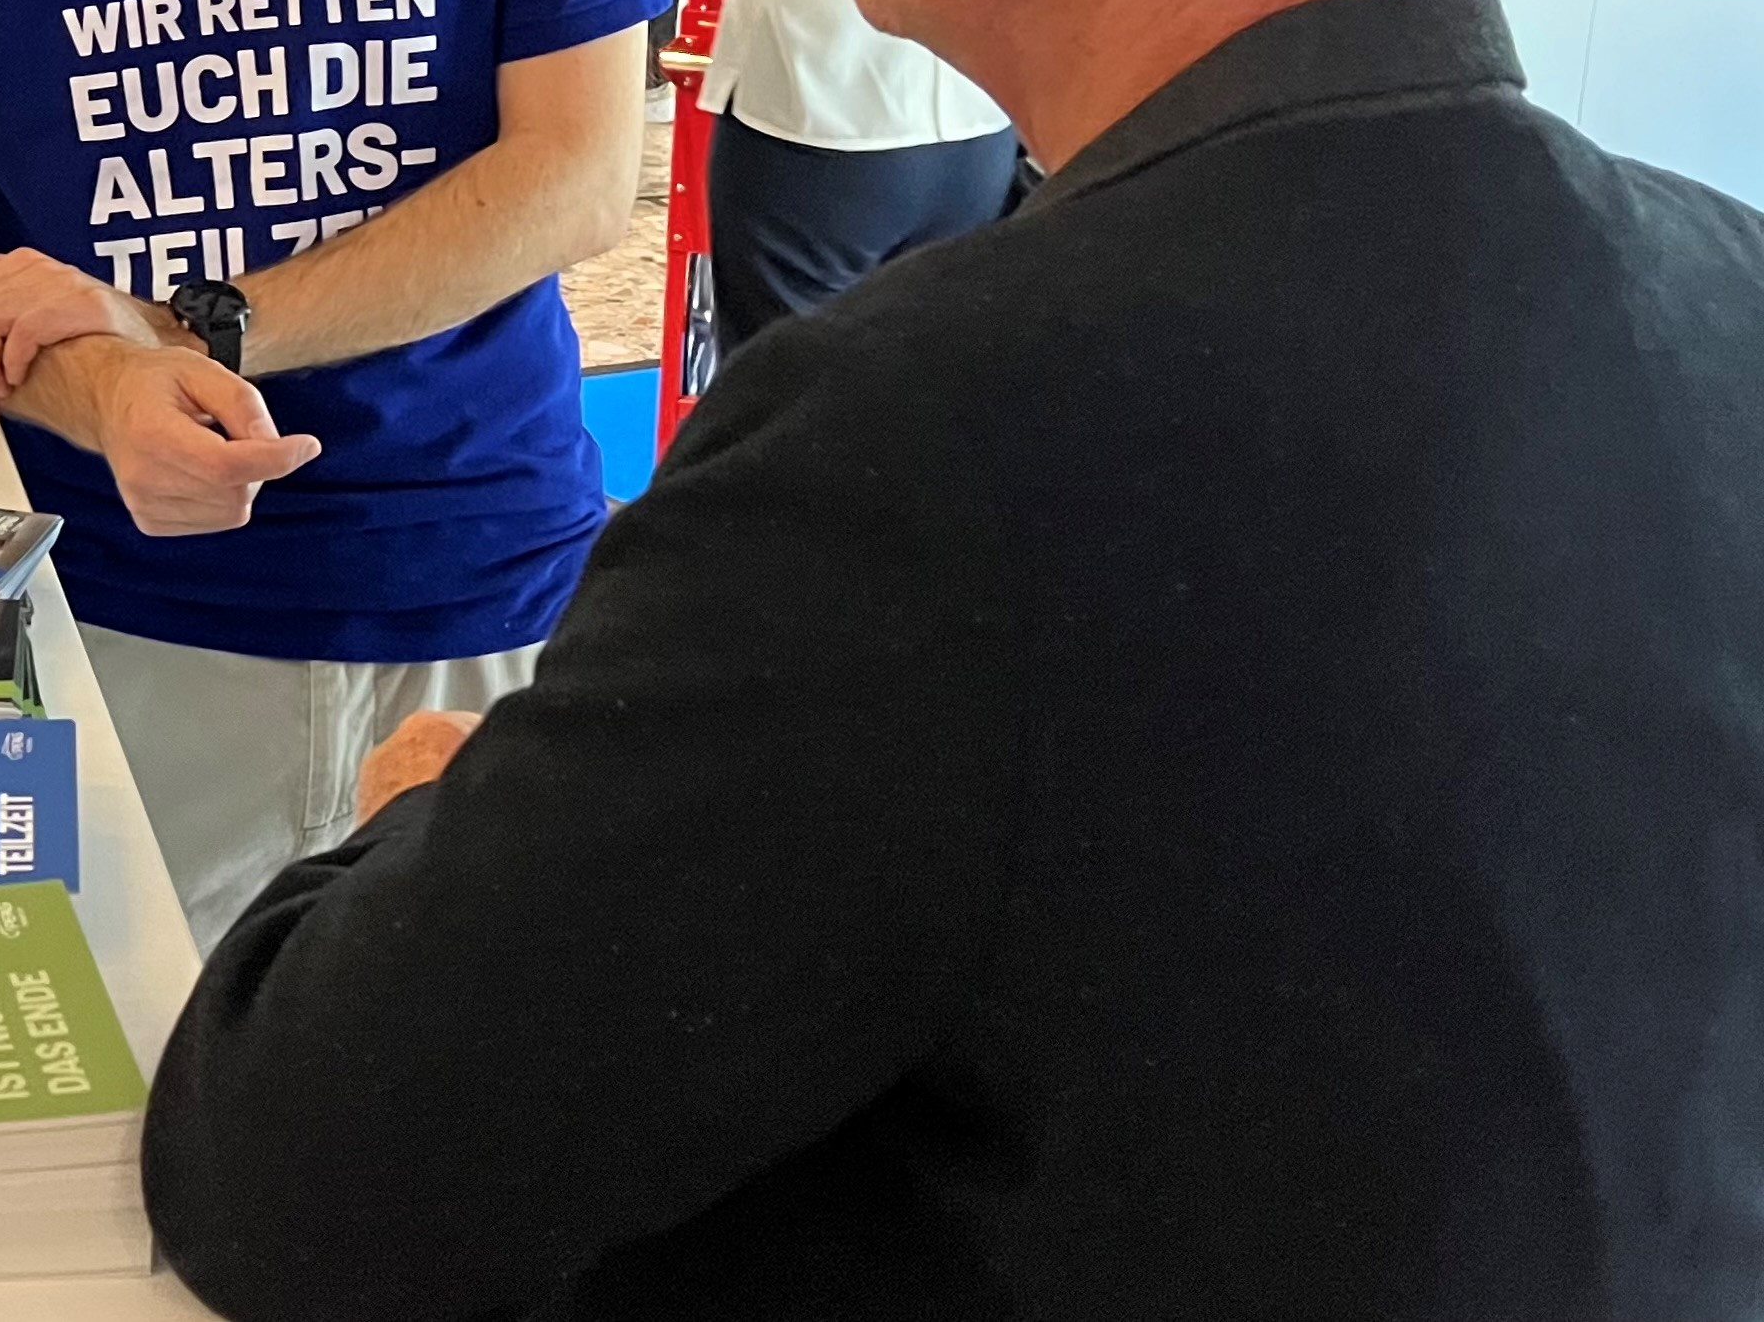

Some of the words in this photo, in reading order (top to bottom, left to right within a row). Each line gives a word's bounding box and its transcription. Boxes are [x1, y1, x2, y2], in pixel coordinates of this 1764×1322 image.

[69, 46, 289, 142] EUCH
[308, 35, 438, 112] DIE
[89, 122, 437, 225] ALTERS-
[8, 969, 69, 1038] ENDE
[35, 1040, 91, 1095] DAS
